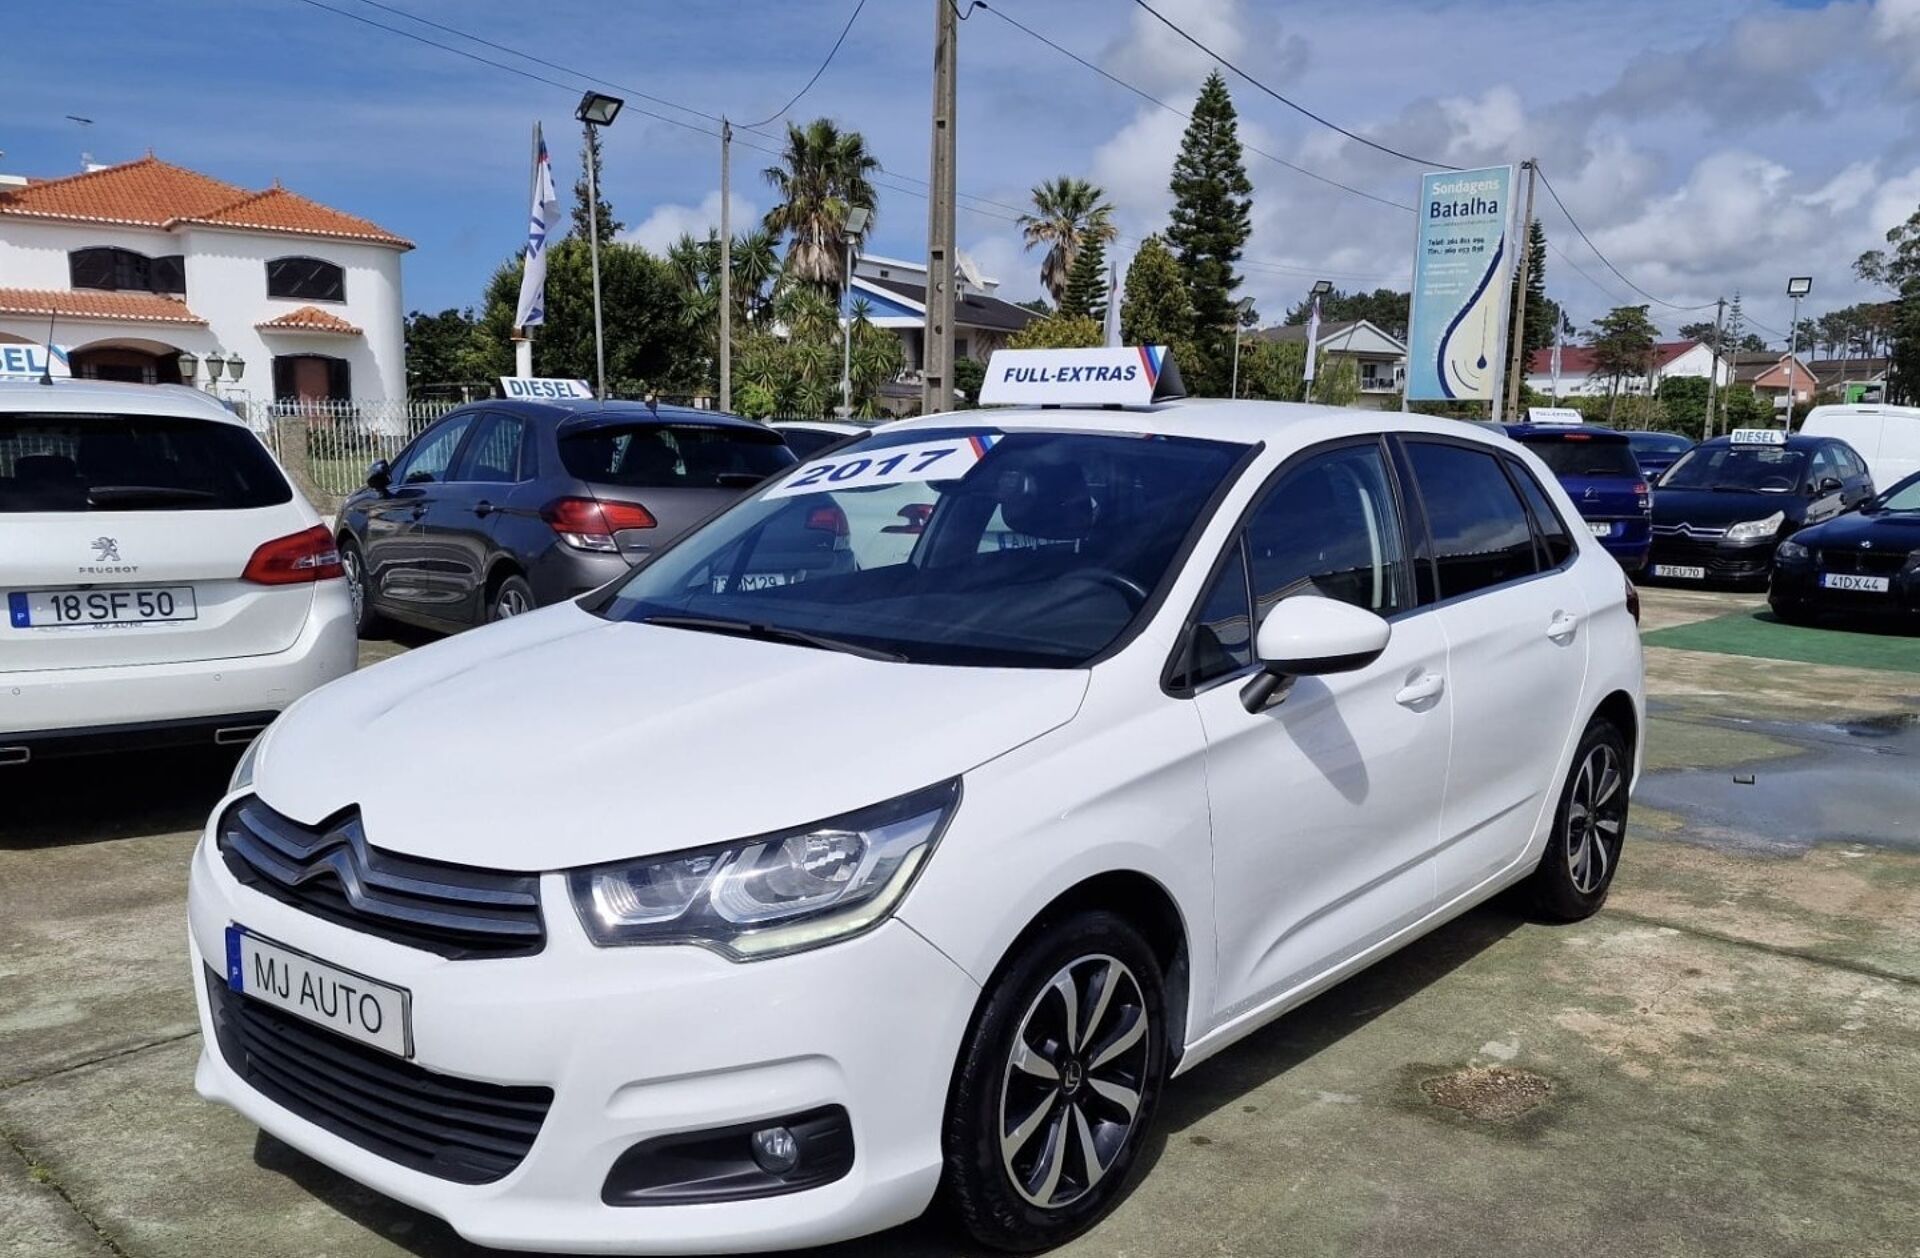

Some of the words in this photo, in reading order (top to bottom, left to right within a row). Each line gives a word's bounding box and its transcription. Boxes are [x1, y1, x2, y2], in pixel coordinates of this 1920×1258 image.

[1432, 179, 1500, 195] Sondagens
[1430, 197, 1498, 218] Batalha
[1003, 365, 1137, 383] FULL-EXTRAS
[509, 380, 581, 398] DIESEL
[1734, 431, 1776, 442] DIESEL
[786, 448, 958, 489] 2017
[78, 566, 139, 574] PEUGEOT
[254, 952, 290, 999] MJ
[299, 971, 383, 1034] AUTO
